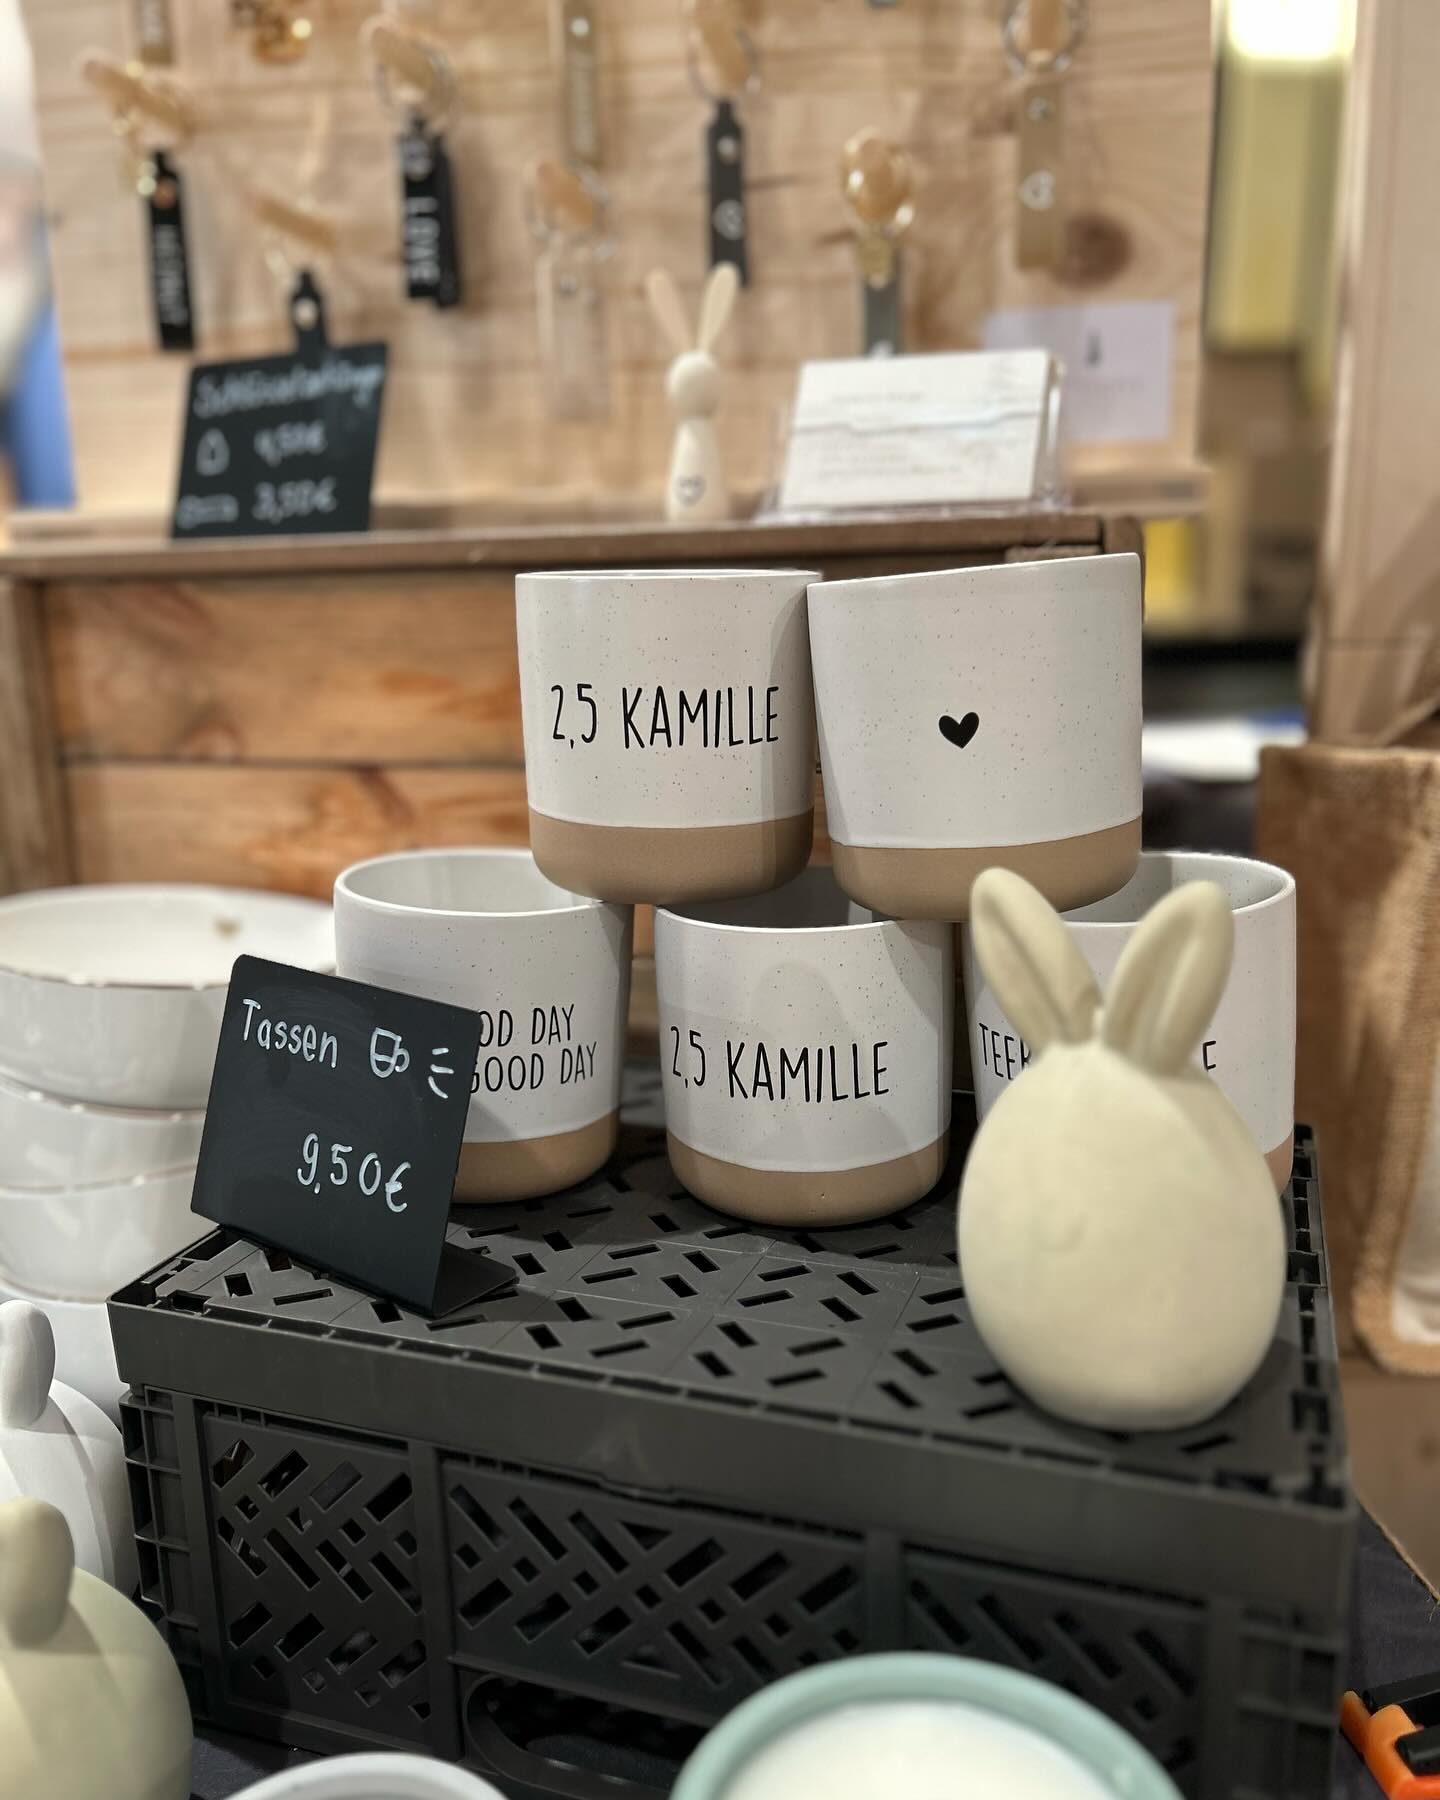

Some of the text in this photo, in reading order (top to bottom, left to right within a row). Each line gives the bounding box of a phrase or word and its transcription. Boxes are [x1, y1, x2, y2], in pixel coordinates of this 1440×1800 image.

[551, 683, 779, 749] 2,5 KAMILLE
[243, 999, 339, 1068] Tassen
[478, 1004, 574, 1047] OD DAY
[560, 1041, 597, 1084] DAY
[670, 1026, 889, 1103] 2,5 KAMILLE
[297, 1132, 411, 1212] 9,50€
